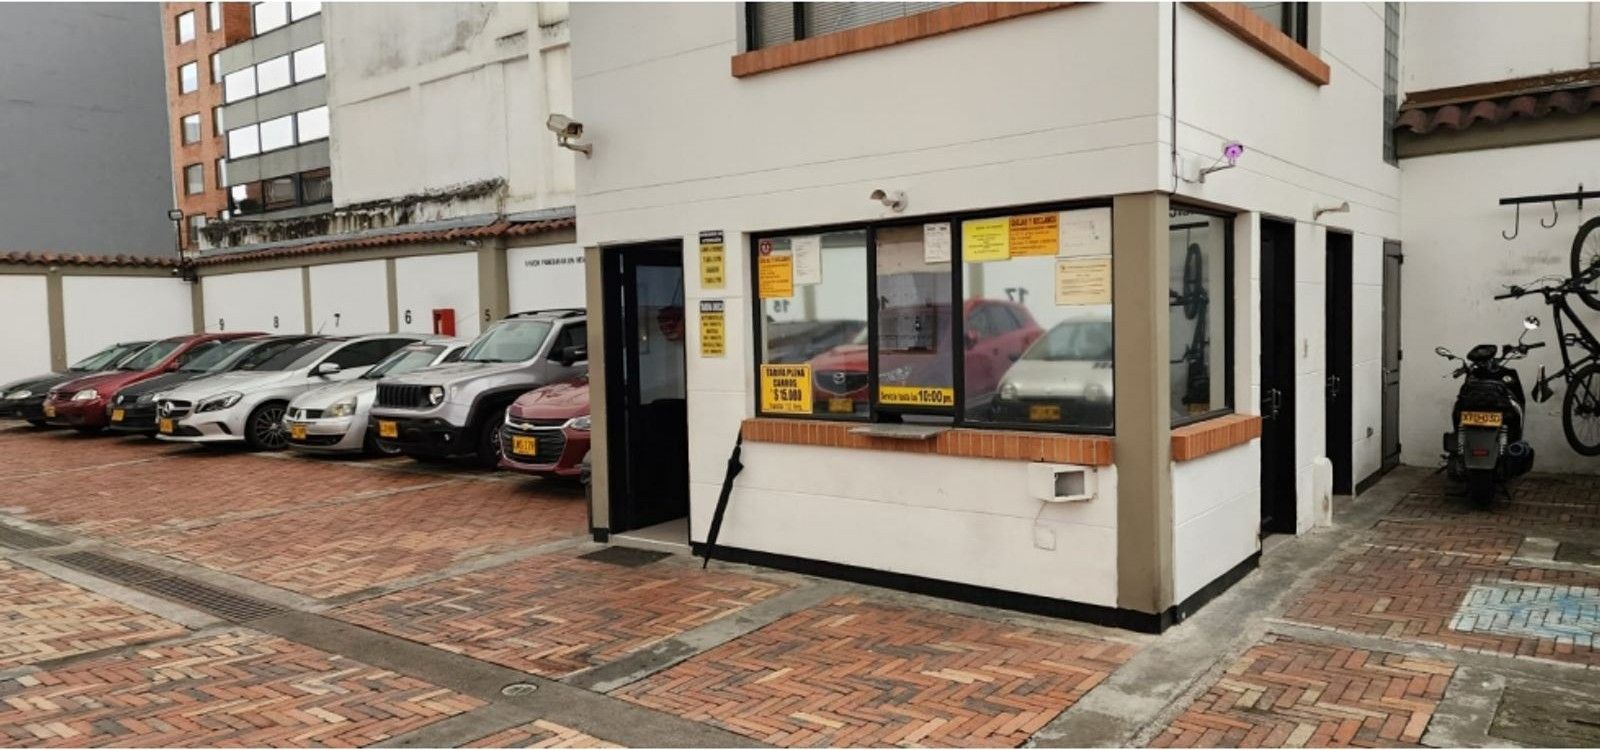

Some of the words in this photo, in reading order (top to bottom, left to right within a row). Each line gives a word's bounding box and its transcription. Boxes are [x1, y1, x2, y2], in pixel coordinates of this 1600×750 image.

[273, 315, 279, 329] 8
[333, 312, 341, 328] 7
[405, 309, 412, 324] 6
[484, 308, 491, 322] 5
[218, 318, 225, 331] 9
[766, 368, 786, 377] TARIFA
[787, 368, 805, 378] PLENA
[773, 379, 797, 388] CARROS
[919, 389, 943, 403] 10:00
